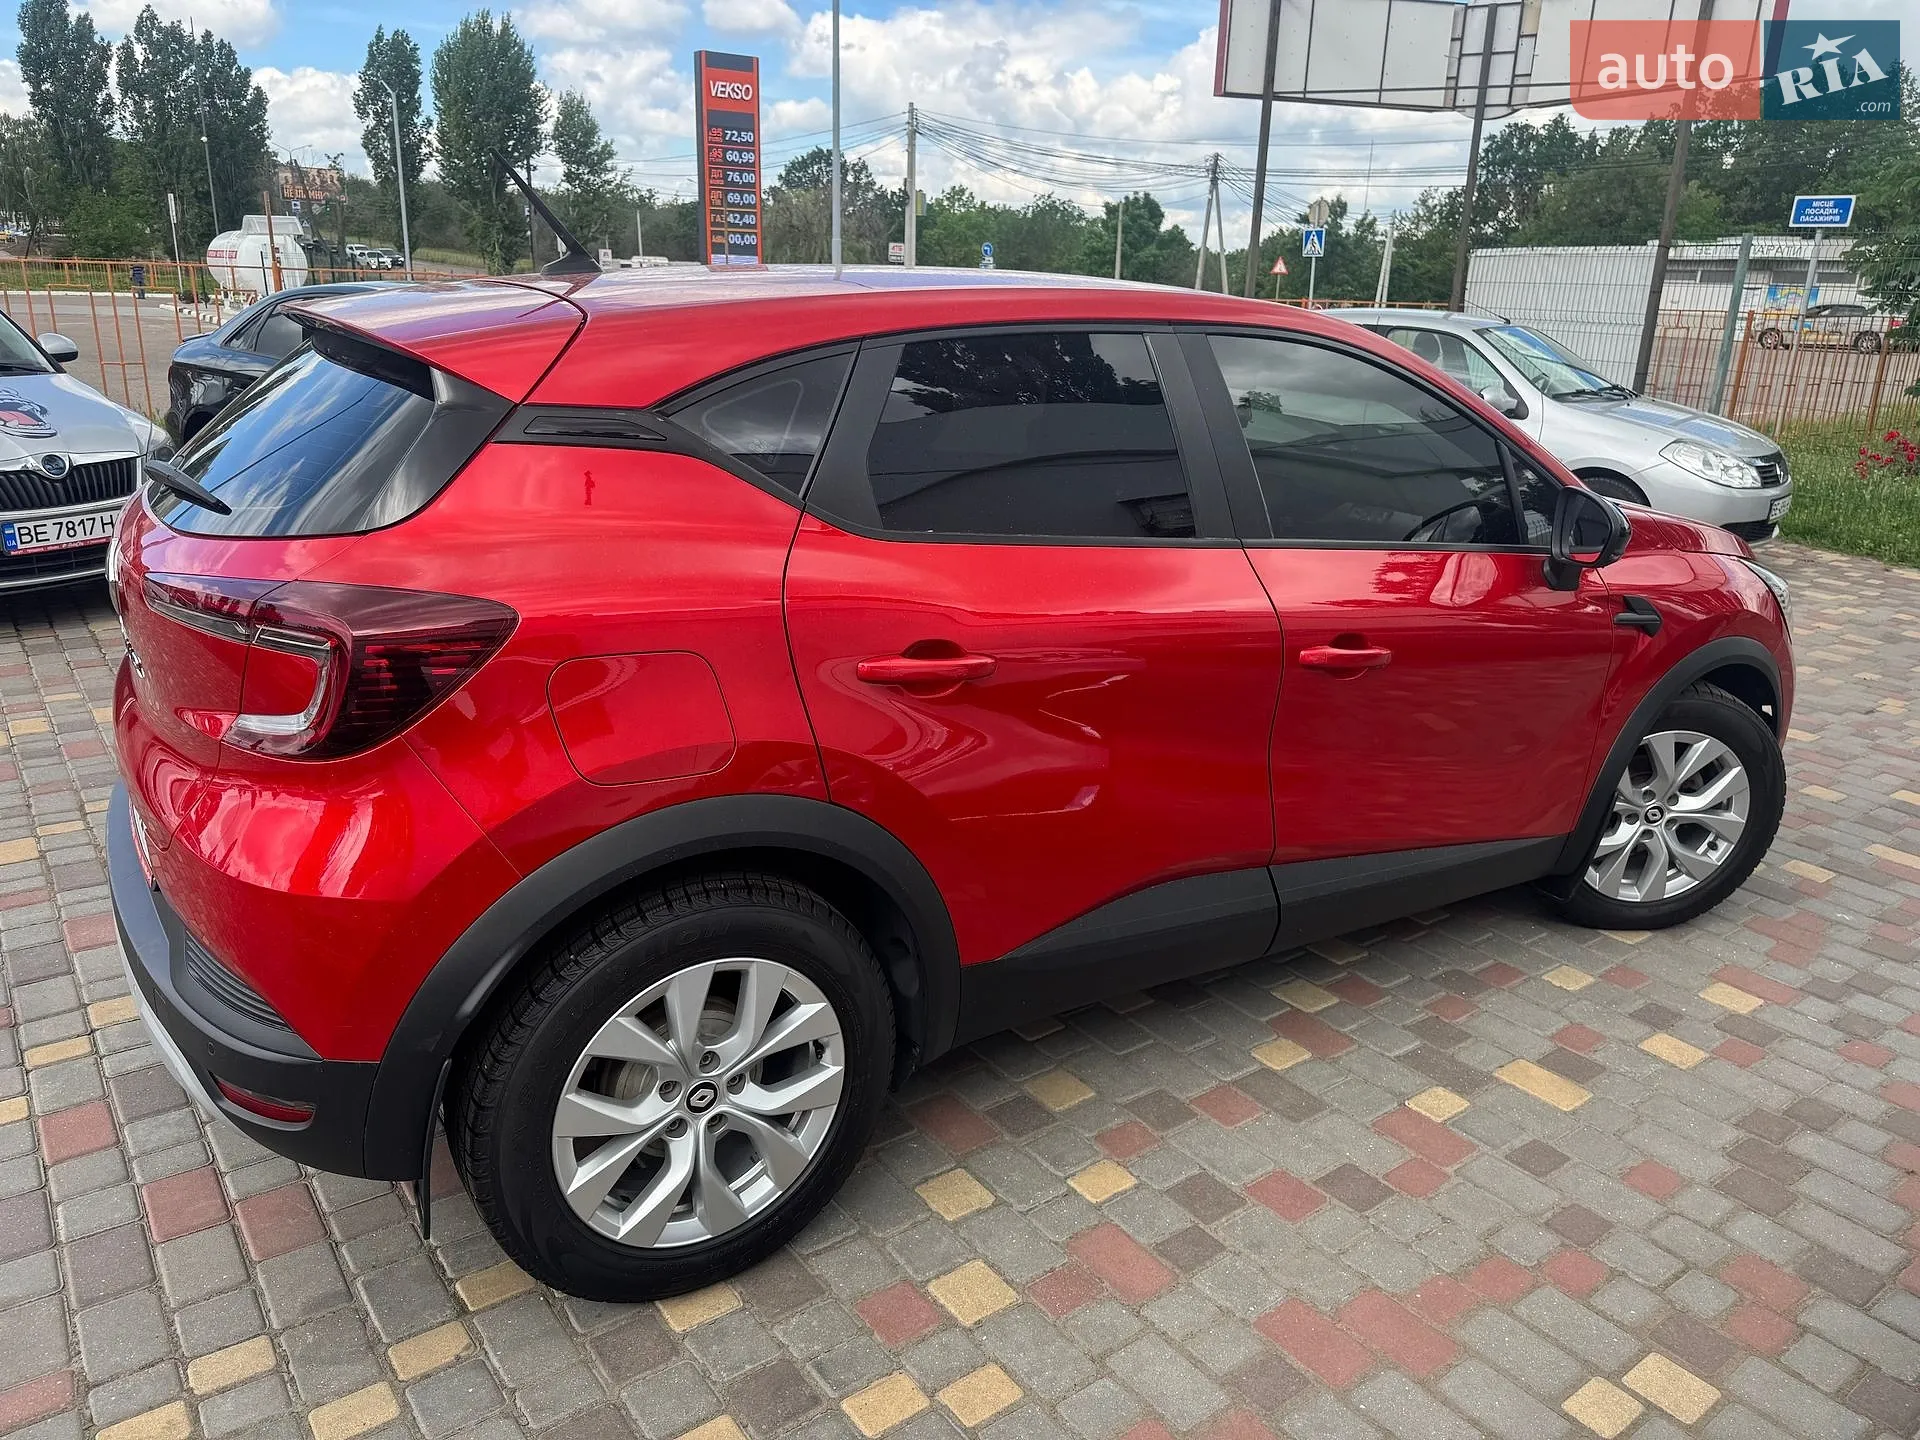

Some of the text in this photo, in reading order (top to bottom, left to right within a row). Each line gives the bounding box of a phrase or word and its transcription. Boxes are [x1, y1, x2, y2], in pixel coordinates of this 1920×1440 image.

[709, 80, 753, 101] VEKSO
[724, 130, 754, 143] 72,50
[725, 150, 755, 164] 60,99
[726, 171, 756, 185] 76,00
[726, 192, 756, 206] 69,00
[1811, 200, 1835, 208] МІСЦЕ
[1804, 208, 1839, 216] ПОСАДКИ
[726, 213, 756, 226] 42,40
[728, 233, 757, 246] 00,00
[17, 523, 51, 545] BE
[52, 517, 97, 542] 7817
